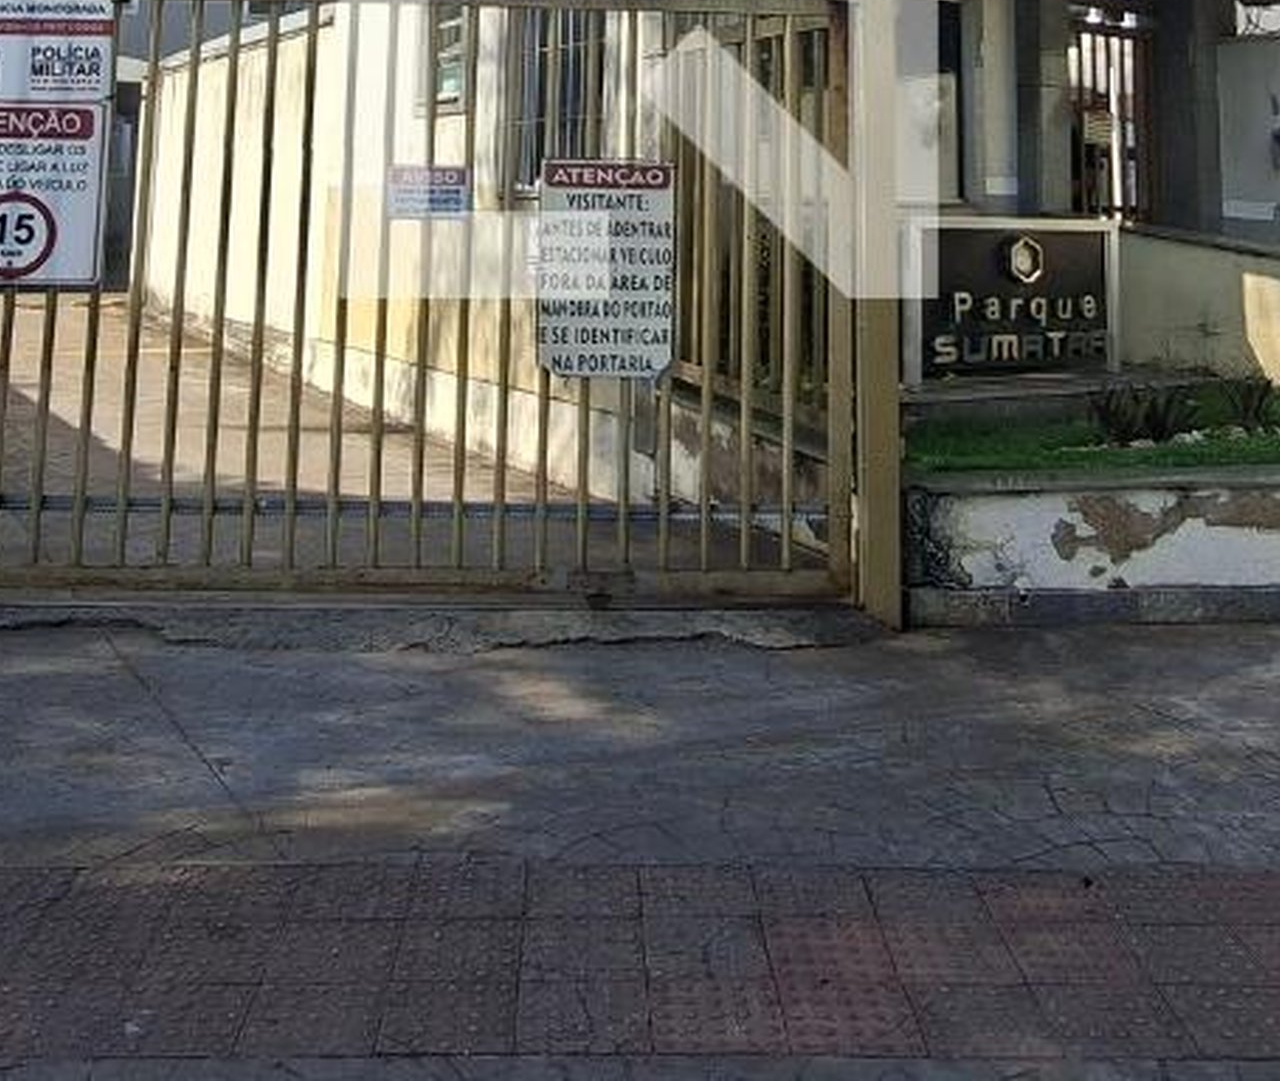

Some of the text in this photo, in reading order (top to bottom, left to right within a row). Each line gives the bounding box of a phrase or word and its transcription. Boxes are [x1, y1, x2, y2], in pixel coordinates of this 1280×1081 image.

[30, 42, 102, 62] POLÍCIA
[30, 62, 102, 77] MILITAR
[7, 160, 47, 173] LIGAR
[565, 192, 650, 211] VISITANTE:
[542, 219, 583, 238] ANTES
[608, 220, 672, 238] ADENTRAR
[540, 272, 580, 291] FORA
[585, 273, 607, 291] DA
[653, 274, 672, 291] DE
[540, 299, 601, 317] MANOBRA
[603, 299, 622, 318] DO
[953, 291, 1097, 327] Parque
[551, 326, 569, 344] SE
[574, 326, 669, 345] IDENTIFICAR
[551, 354, 654, 372] NA PORTARIA
